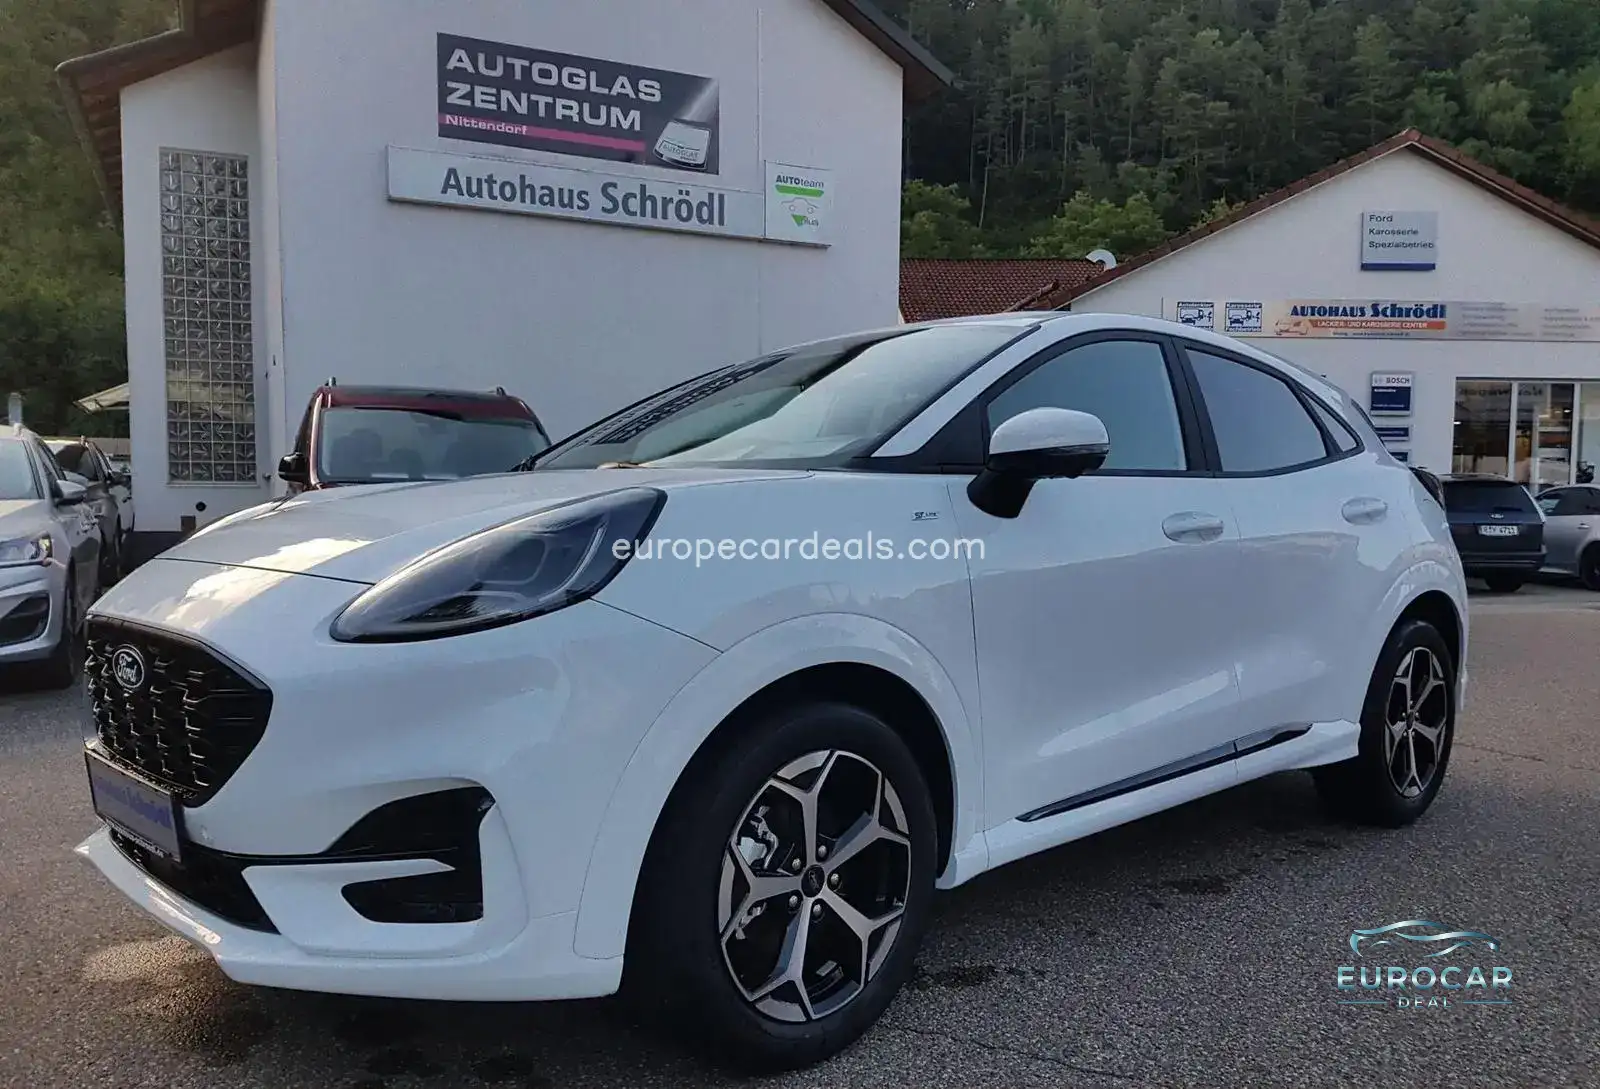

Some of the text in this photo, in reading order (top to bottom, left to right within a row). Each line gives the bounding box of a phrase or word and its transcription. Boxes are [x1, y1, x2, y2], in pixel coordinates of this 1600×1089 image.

[446, 48, 662, 103] AUTOGLAS
[446, 82, 641, 131] ZENTRUM
[445, 114, 528, 136] Nittendorf
[775, 174, 825, 189] AUTOteam
[440, 167, 725, 227] Autohaus Schrödl
[1369, 214, 1393, 222] Ford
[1368, 240, 1435, 249] Spezialbetrieb
[1290, 304, 1366, 318] AUTOHAUS
[1370, 303, 1447, 319] Schrödl
[117, 653, 138, 683] Ford
